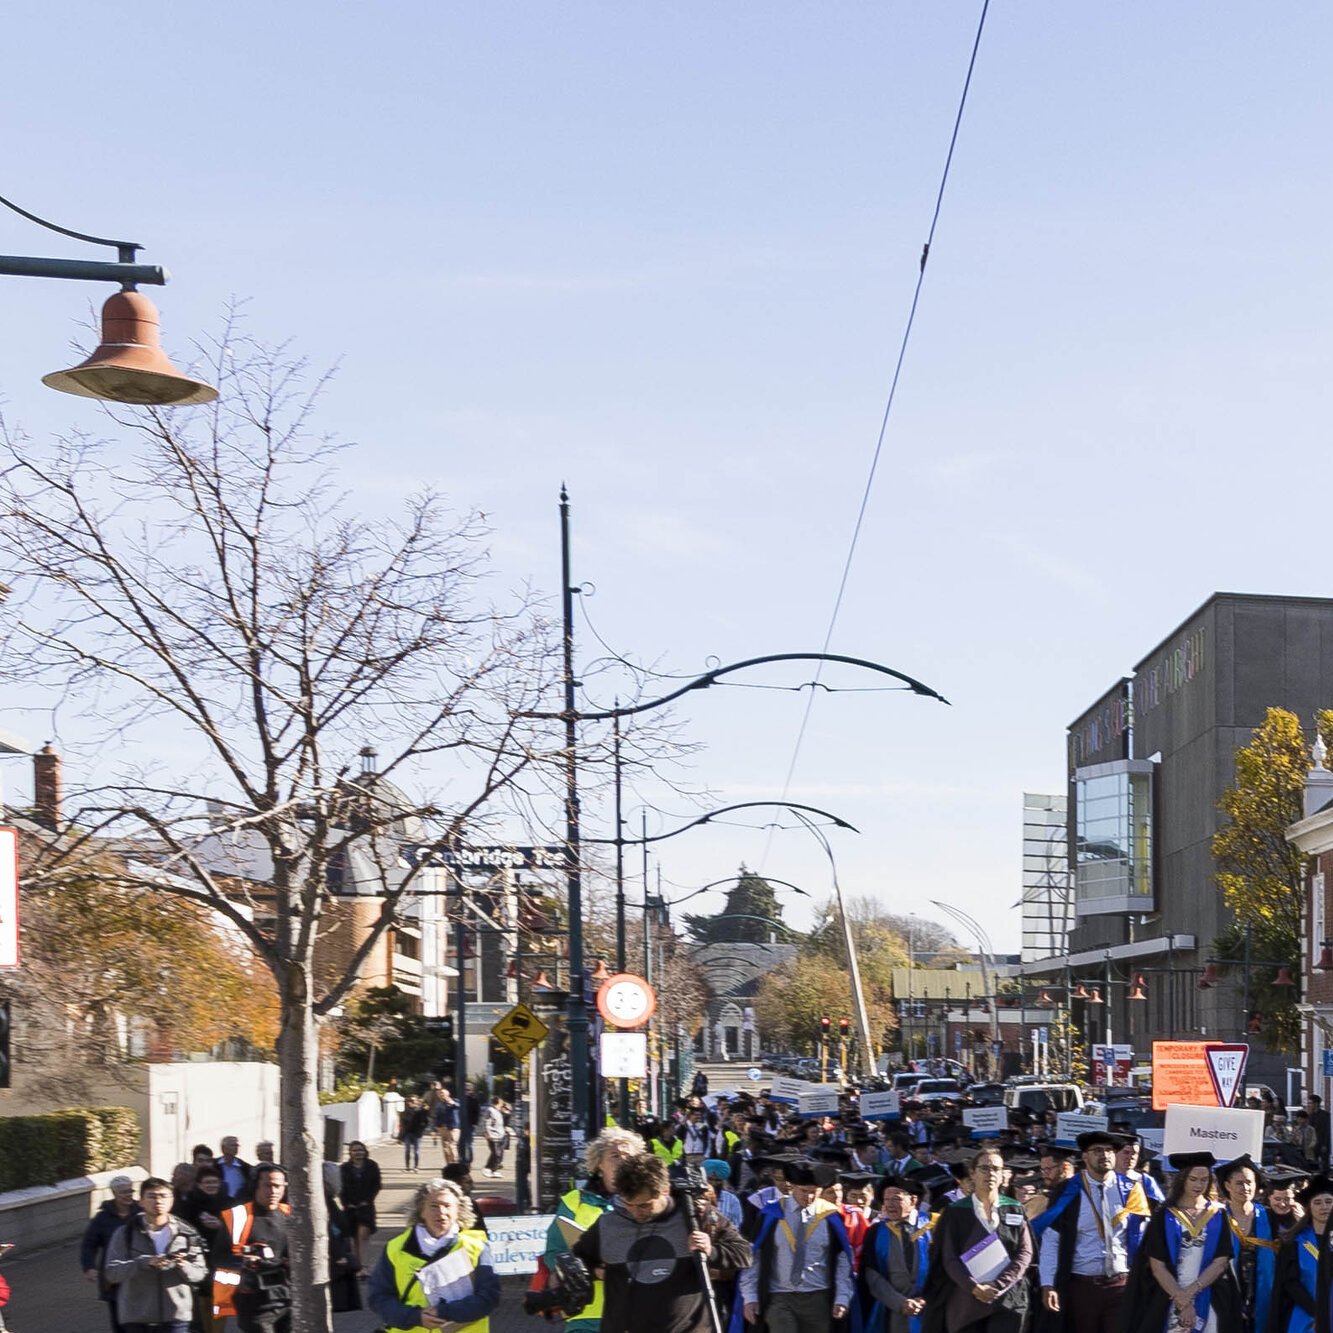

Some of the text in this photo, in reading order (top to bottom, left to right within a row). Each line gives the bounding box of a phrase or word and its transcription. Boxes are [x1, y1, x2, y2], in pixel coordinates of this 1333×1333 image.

[1217, 1056, 1237, 1071] GIVE
[1221, 1077, 1234, 1087] WAY
[1189, 1127, 1238, 1140] Masters
[487, 1229, 548, 1242] orceste
